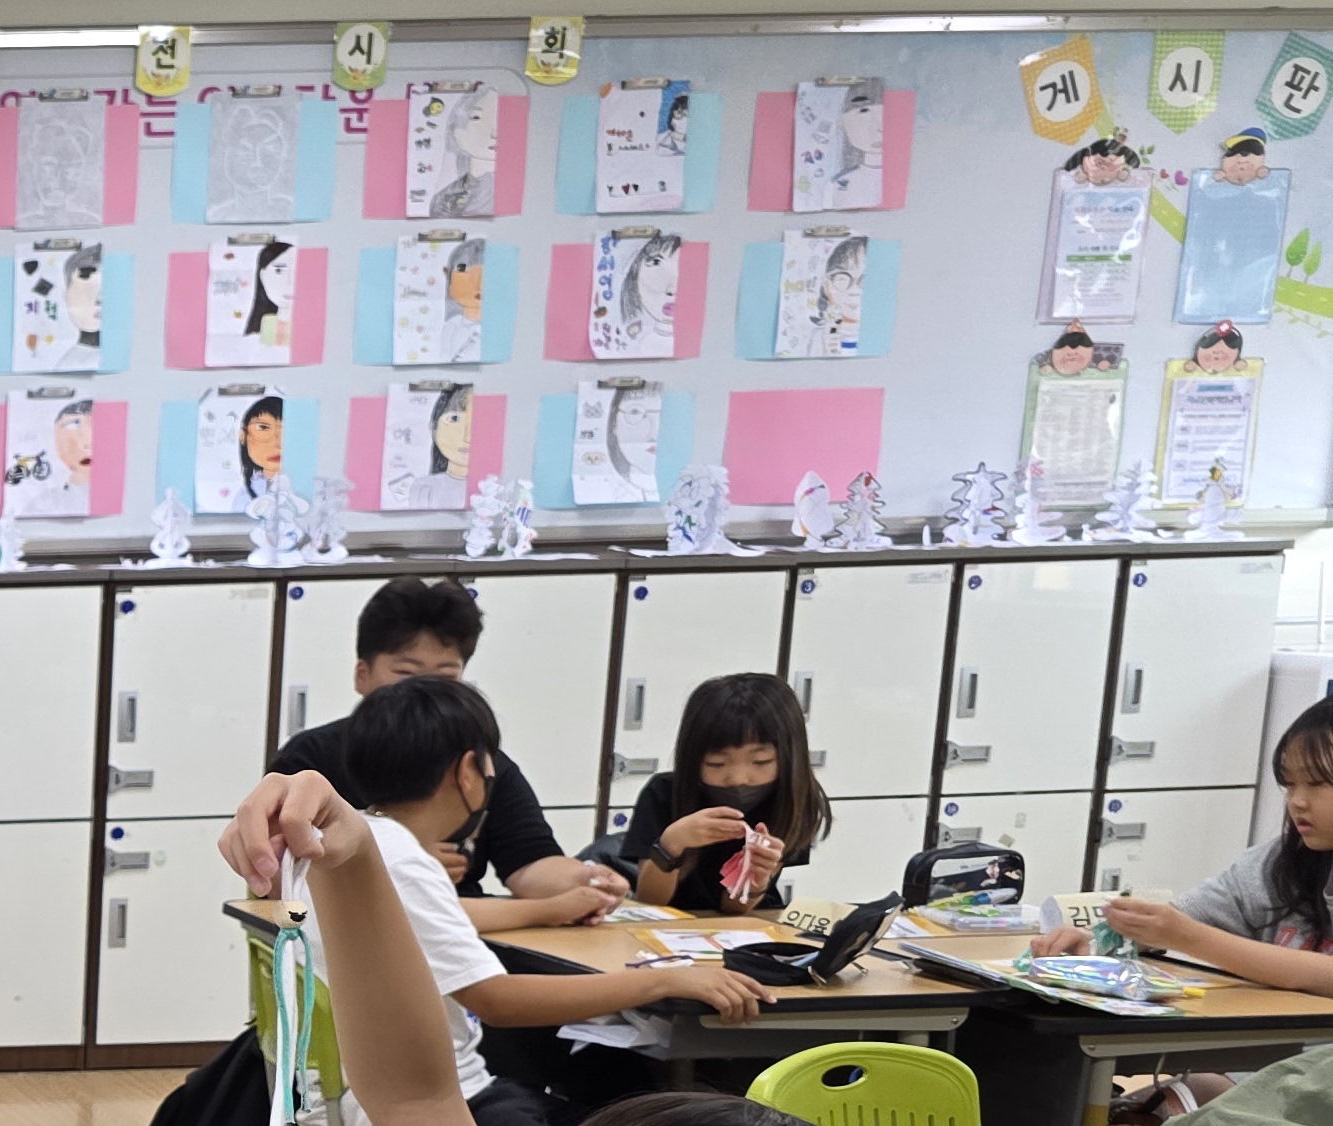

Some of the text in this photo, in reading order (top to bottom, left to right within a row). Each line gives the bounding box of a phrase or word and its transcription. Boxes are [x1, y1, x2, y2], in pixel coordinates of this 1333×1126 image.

[348, 32, 373, 66] 시
[540, 27, 566, 60] 회
[1038, 60, 1324, 116] 게 시 판
